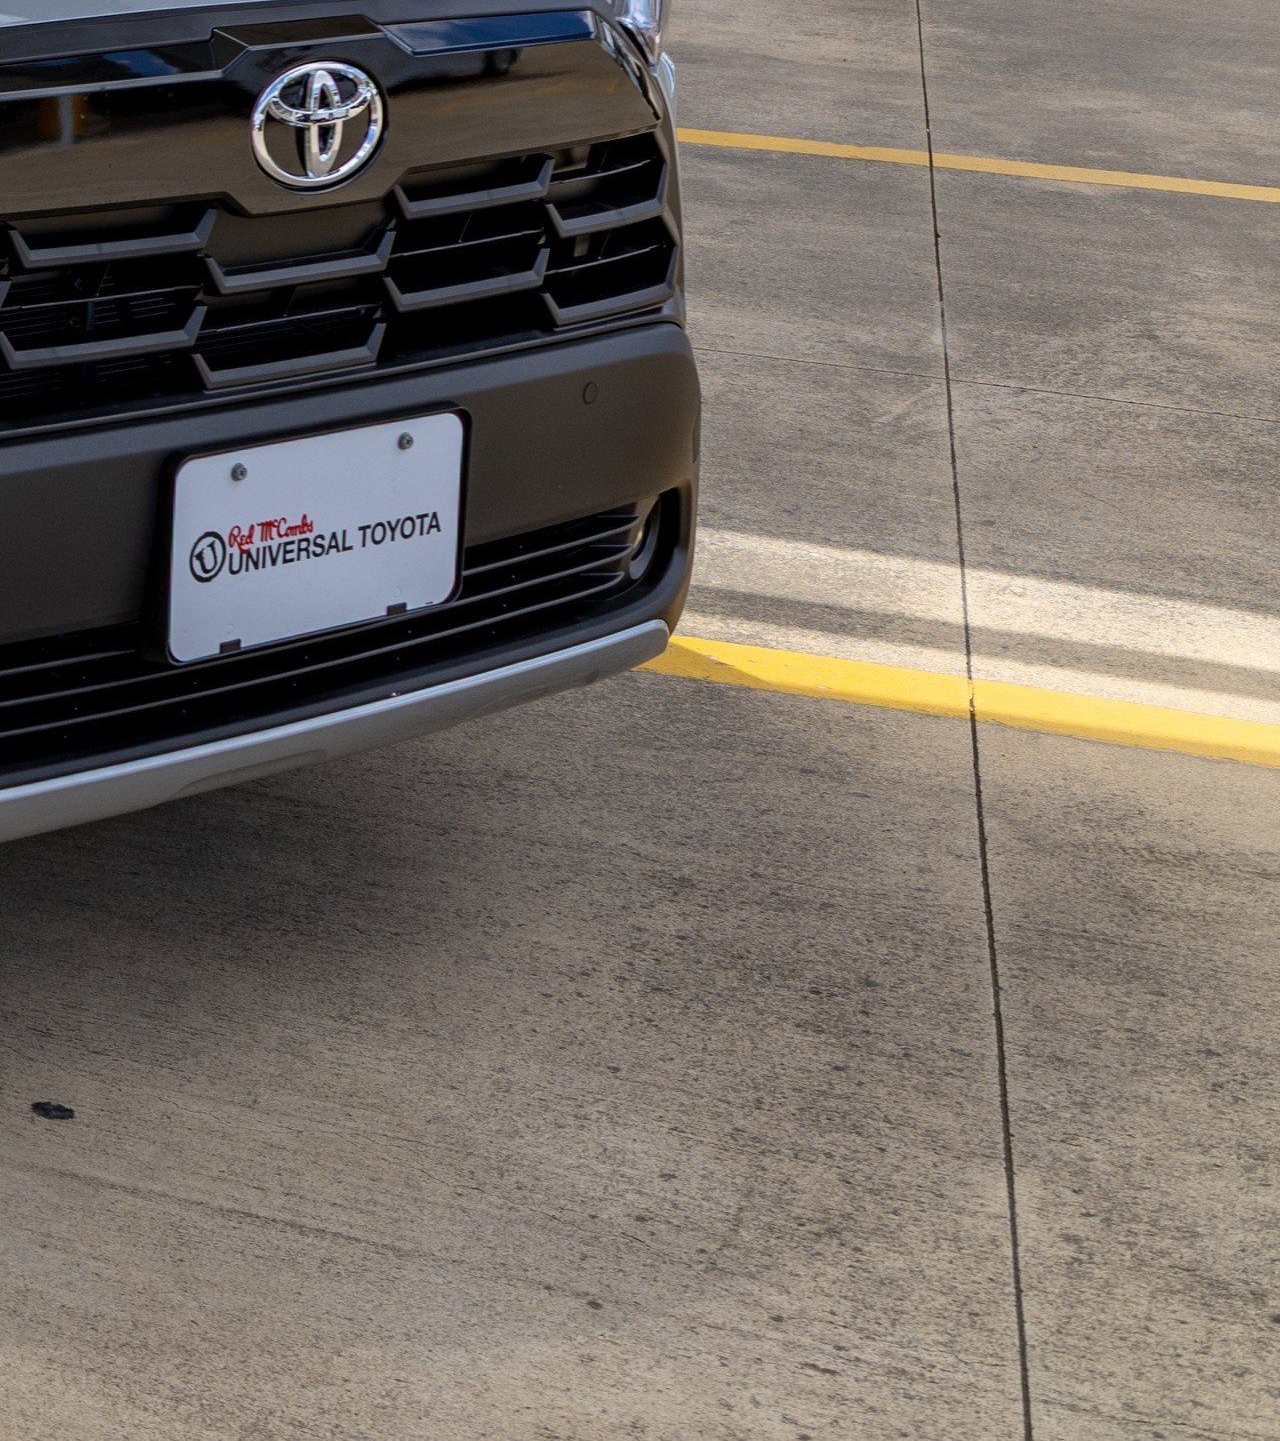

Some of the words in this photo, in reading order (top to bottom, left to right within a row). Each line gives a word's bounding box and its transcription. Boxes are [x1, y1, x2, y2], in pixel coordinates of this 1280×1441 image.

[228, 524, 254, 554] Red
[228, 529, 353, 576] UNIVERSAL
[358, 511, 442, 548] TOYOTA
